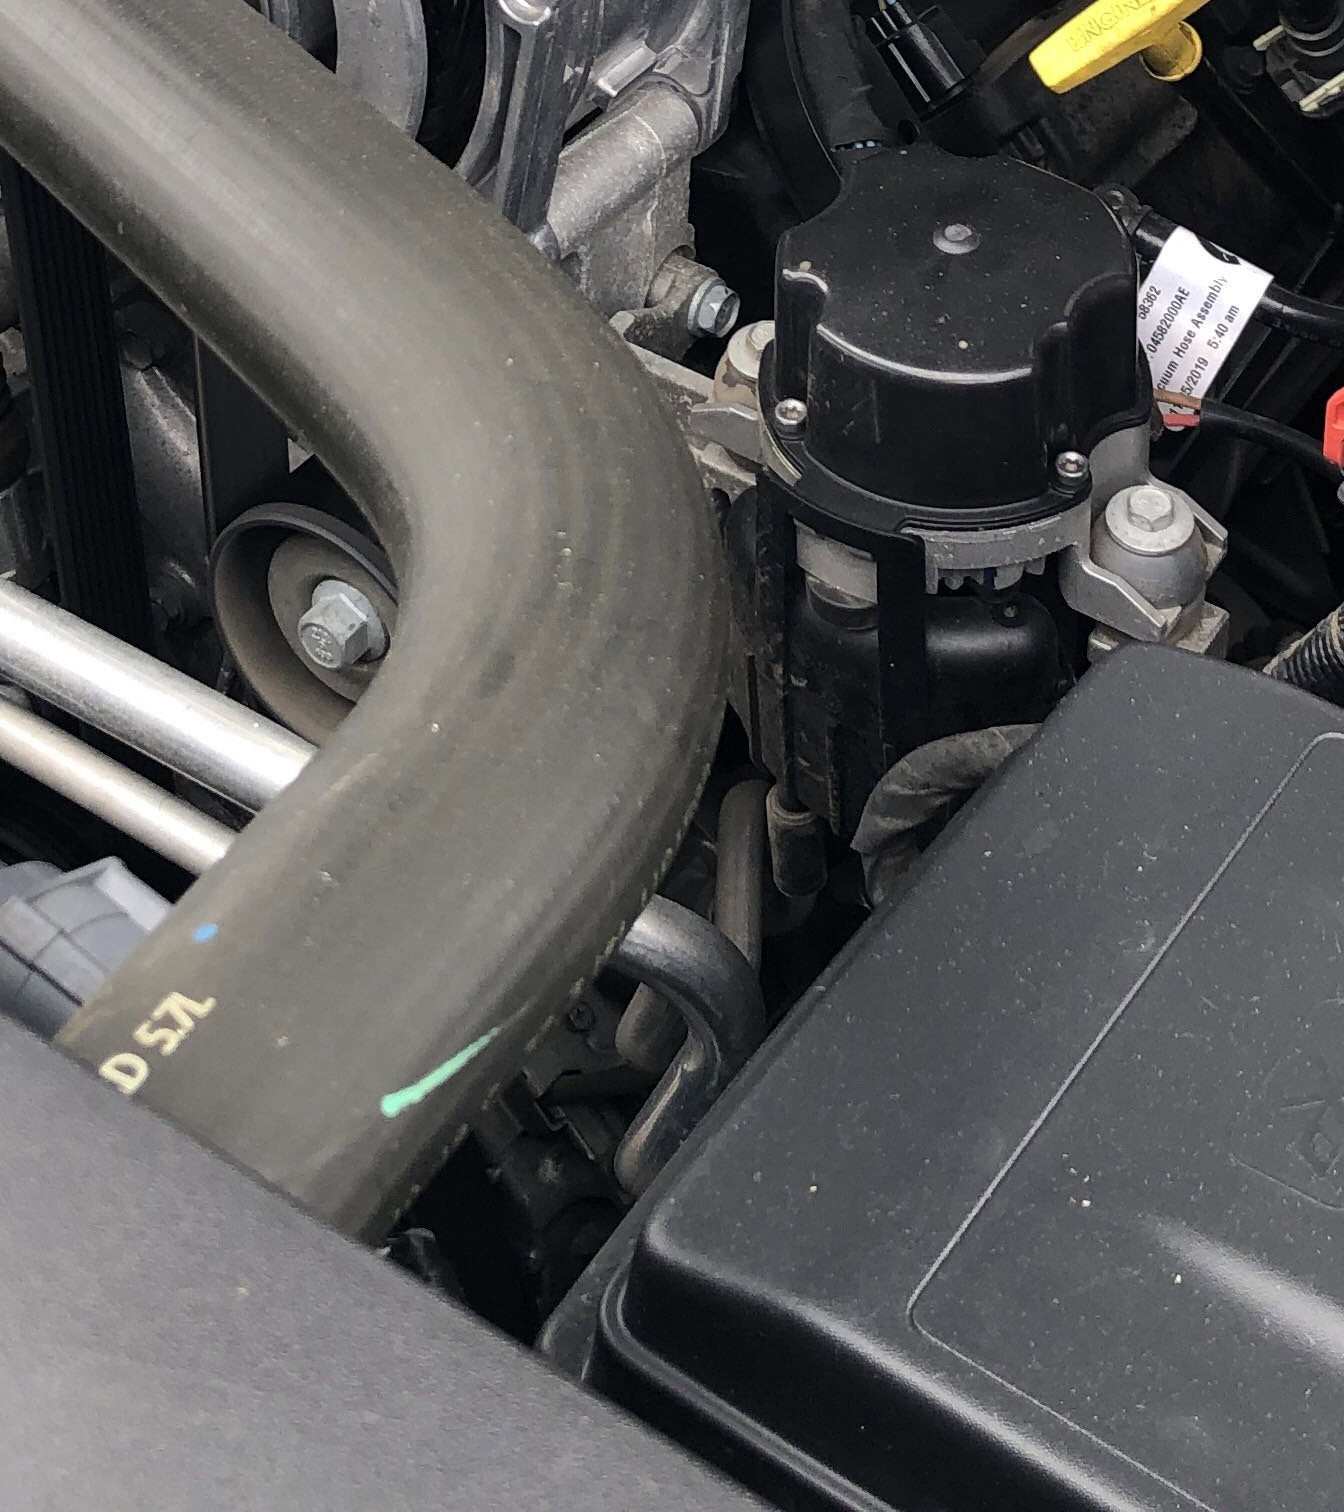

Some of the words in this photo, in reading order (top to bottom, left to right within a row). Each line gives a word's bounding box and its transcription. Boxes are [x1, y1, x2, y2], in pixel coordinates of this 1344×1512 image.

[1155, 359, 1180, 392] cuum
[1172, 327, 1197, 359] Hose
[1188, 273, 1230, 330] Assembly
[1206, 322, 1230, 351] 5:40
[1223, 303, 1241, 324] am
